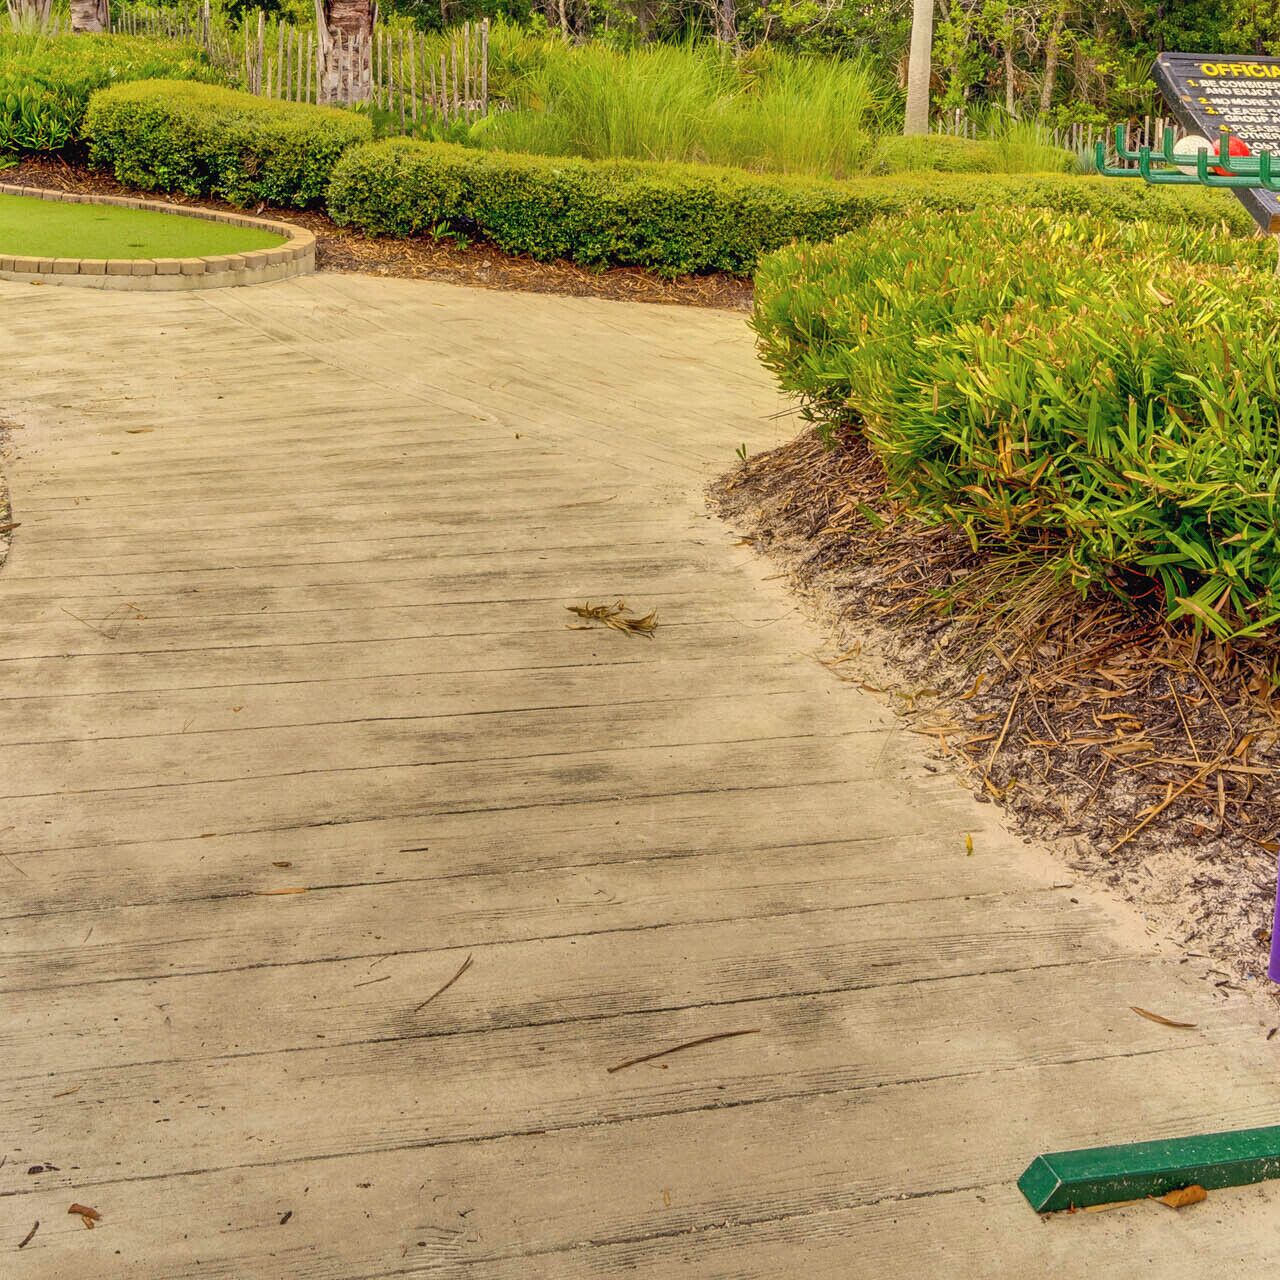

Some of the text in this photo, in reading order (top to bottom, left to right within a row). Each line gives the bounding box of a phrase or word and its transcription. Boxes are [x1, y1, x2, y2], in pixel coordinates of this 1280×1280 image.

[1186, 79, 1199, 87] 1.
[1200, 80, 1218, 88] BE
[1205, 87, 1233, 95] AND
[1233, 88, 1273, 97] ENJOY
[1231, 98, 1269, 107] MORE
[1217, 107, 1269, 116] PLEASE
[1224, 115, 1269, 123] GROUP
[1245, 141, 1280, 150] LOST
